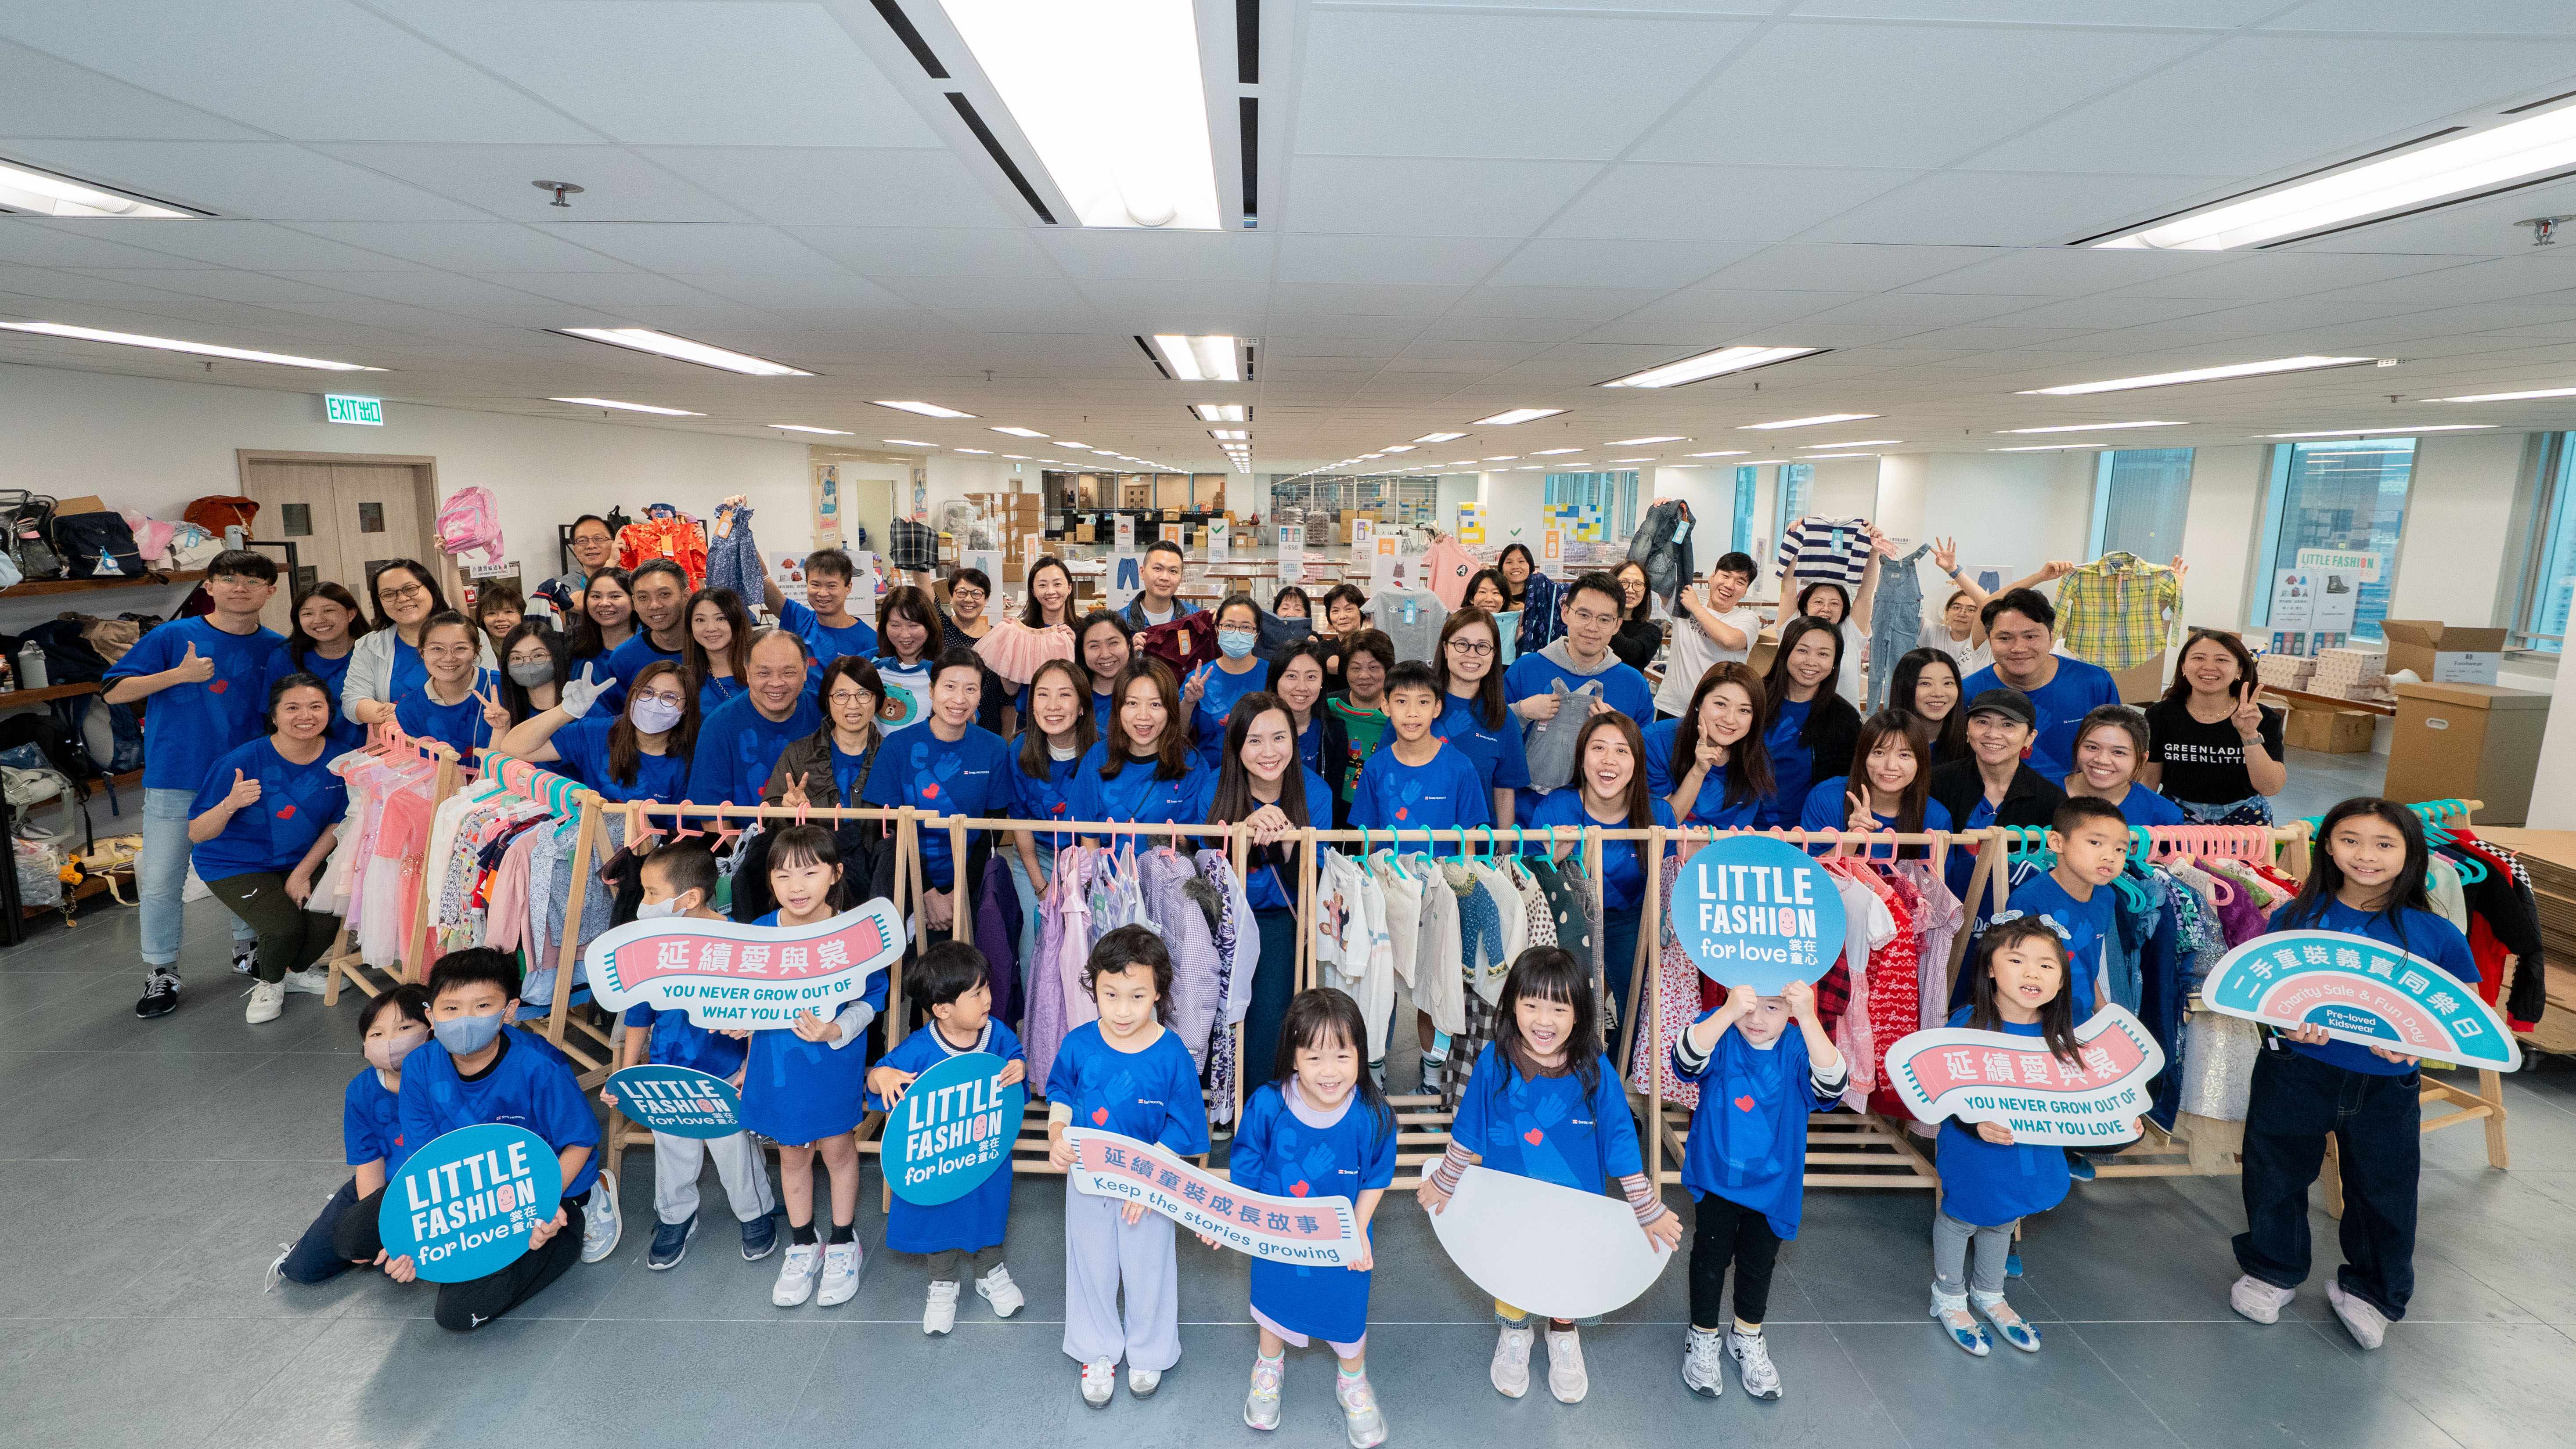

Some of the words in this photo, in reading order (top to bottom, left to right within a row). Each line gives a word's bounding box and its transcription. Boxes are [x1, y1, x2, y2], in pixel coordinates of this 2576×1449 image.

[328, 398, 357, 421] EXIT
[358, 401, 381, 422] 出口
[2302, 553, 2330, 566] LITTLE
[2332, 555, 2374, 569] FASHION
[2164, 743, 2244, 755] GREENLADI
[1698, 864, 1813, 905] LITTLE
[1700, 904, 1817, 938] FASHION
[656, 939, 850, 975] 延續愛與裳
[1701, 938, 1737, 959] for
[1740, 939, 1787, 962] love
[1789, 939, 1817, 952] 裳在
[1790, 952, 1818, 966] 童心
[663, 985, 695, 998] YOU
[699, 987, 749, 1000] NEVER
[754, 988, 798, 1001] GROW
[802, 985, 830, 1000] OUT
[835, 978, 853, 993] OF
[2234, 945, 2484, 1038] 二手童裝義賣同樂日
[703, 1006, 747, 1019] WHAT
[750, 1006, 781, 1020] YOU
[2277, 986, 2322, 1016] Charity
[2324, 983, 2355, 998] Sale
[2359, 989, 2369, 1001] &
[2374, 997, 2403, 1020] Fun
[2402, 1017, 2427, 1044] Day
[2326, 1009, 2376, 1026] Pre-loved
[2328, 1018, 2374, 1034] Kidswear
[1943, 1047, 2122, 1088] 延續愛與裳
[617, 1079, 720, 1099] LITTLE
[1964, 1096, 1995, 1110] YOU
[2000, 1098, 2046, 1113] NEVER
[2051, 1100, 2091, 1114] GROW
[2095, 1097, 2121, 1114] OUT
[2124, 1088, 2136, 1104] OF
[633, 1098, 730, 1114] FASHION
[908, 1074, 1003, 1132] LITTLE
[648, 1115, 676, 1125] for
[678, 1116, 715, 1125] love
[2009, 1118, 2052, 1133] WHAT
[2056, 1121, 2085, 1135] YOU
[2089, 1120, 2125, 1136] LOVE
[906, 1109, 1002, 1162] FASHION
[978, 1137, 999, 1153] 裳在
[977, 1149, 999, 1164] 童心
[405, 1141, 530, 1211] LITTLE
[905, 1164, 936, 1186] for
[938, 1152, 976, 1175] love
[1105, 1146, 1319, 1234] 延續童裝成長故事
[411, 1177, 535, 1242] FASHION
[510, 1205, 537, 1223] 裳在
[1094, 1177, 1141, 1199] Keep
[1149, 1192, 1179, 1213] the
[1185, 1211, 1250, 1246] stories
[1259, 1242, 1341, 1263] growing
[512, 1218, 535, 1234] 童心
[418, 1241, 457, 1265] for
[461, 1223, 509, 1251] love
